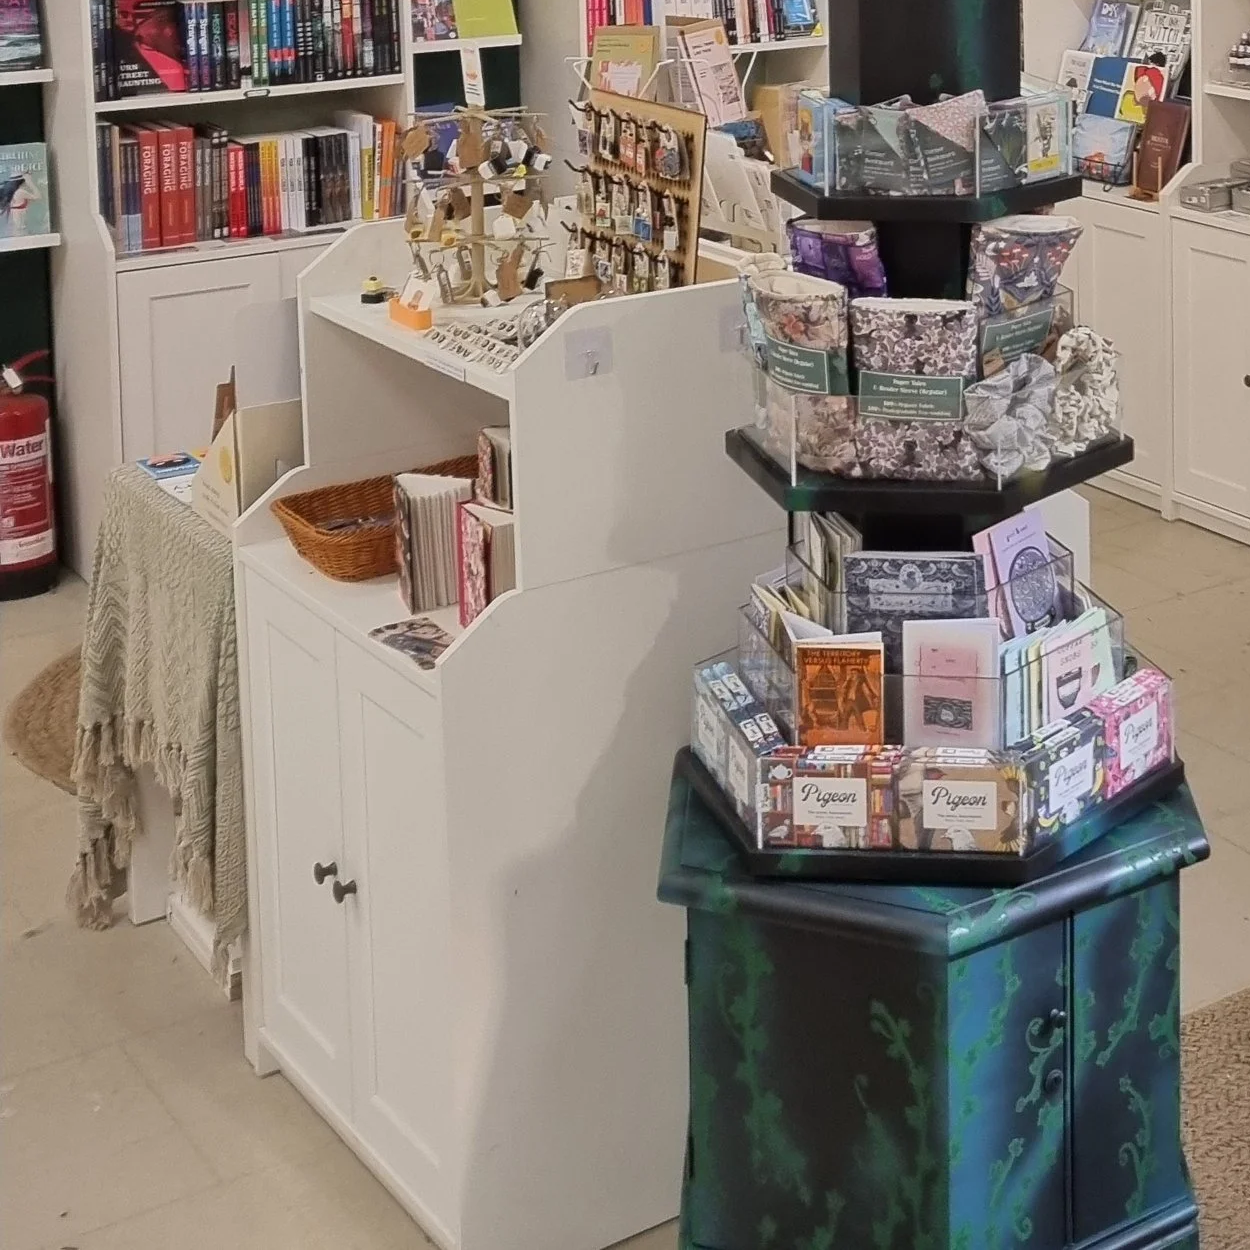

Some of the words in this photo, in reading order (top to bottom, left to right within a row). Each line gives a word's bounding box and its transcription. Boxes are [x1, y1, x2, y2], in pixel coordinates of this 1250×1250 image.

[187, 19, 195, 55] Strangers
[199, 18, 208, 55] Strangers
[1149, 25, 1179, 42] WITCH
[119, 71, 149, 79] TREET
[142, 146, 151, 194] FORAGING
[162, 144, 171, 192] FORAGING
[179, 142, 187, 189] FORAGING
[0, 439, 44, 458] Water
[801, 783, 857, 808] Pigeon
[931, 786, 988, 812] Pigeon
